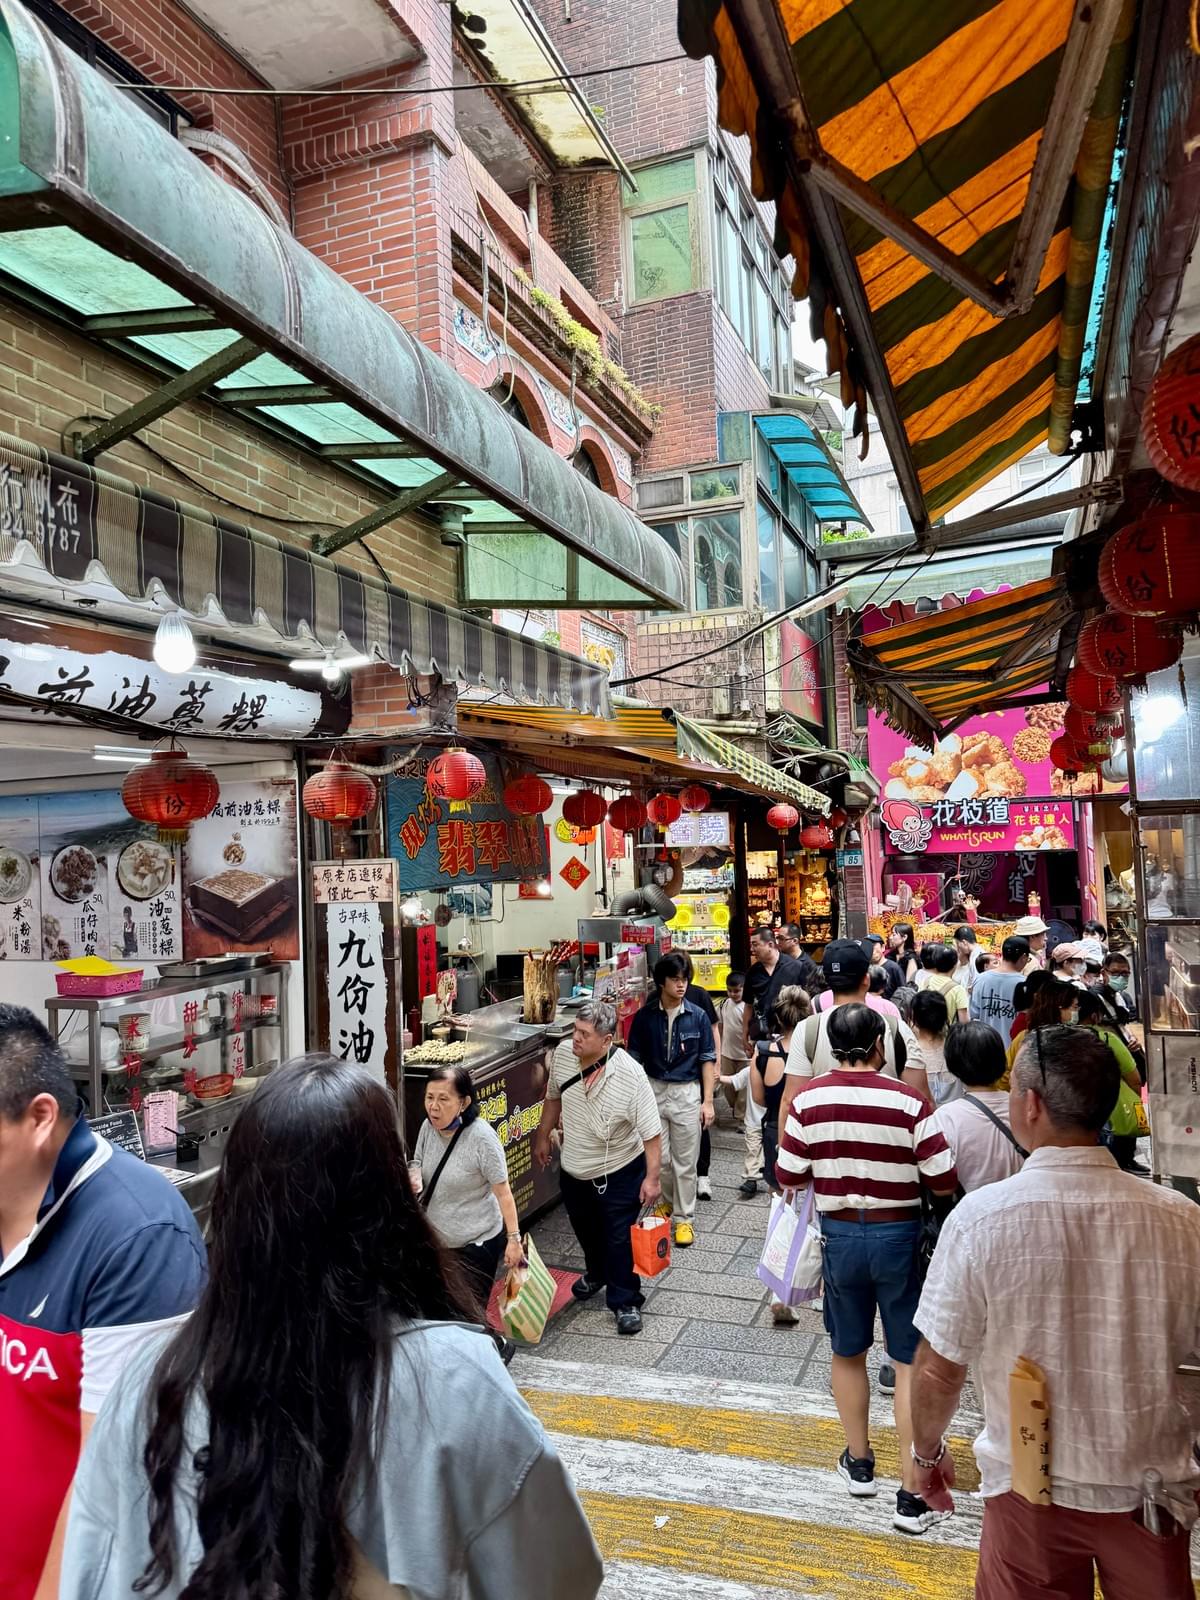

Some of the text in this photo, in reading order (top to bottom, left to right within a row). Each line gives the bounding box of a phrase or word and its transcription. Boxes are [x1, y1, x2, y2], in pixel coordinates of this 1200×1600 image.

[931, 798, 1010, 827] 花枝道
[327, 885, 380, 902] 僅此一家
[12, 904, 32, 955] 米粉湯
[338, 908, 370, 924] 古早味
[337, 928, 376, 1064] 九份油
